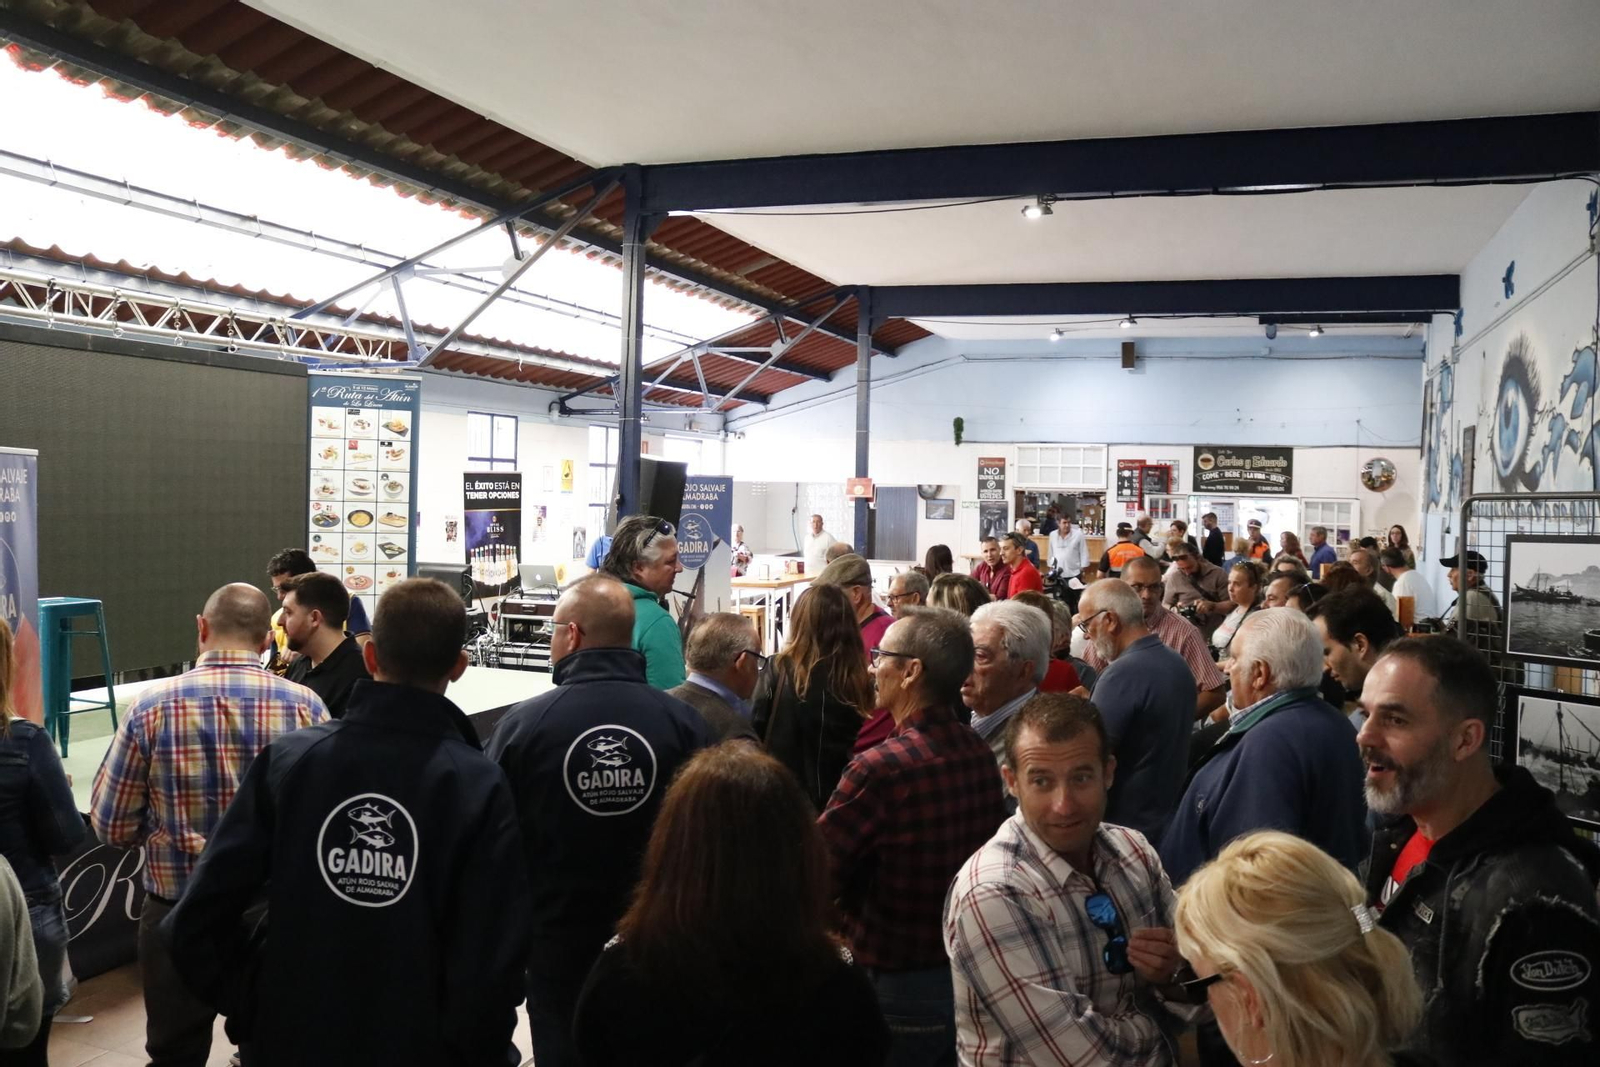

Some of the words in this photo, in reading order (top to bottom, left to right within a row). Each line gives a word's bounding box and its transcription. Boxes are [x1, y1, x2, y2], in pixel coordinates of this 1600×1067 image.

[327, 385, 362, 399] Ruta
[375, 388, 411, 402] Atún
[1216, 455, 1244, 467] Carlos
[1252, 456, 1288, 468] Eduardo
[0, 468, 27, 484] ALVAJE
[983, 467, 999, 475] NO
[1202, 472, 1219, 480] COME
[465, 482, 473, 490] EL
[475, 480, 493, 490] ÉXITO
[494, 481, 510, 490] ESTÁ
[511, 482, 520, 490] EN
[684, 483, 698, 492] OJO
[699, 484, 726, 492] SALVAJE
[466, 491, 488, 499] TENER
[489, 491, 519, 499] OPCIONES
[683, 493, 719, 501] MADRABA
[677, 541, 709, 553] GADIRA
[577, 767, 645, 790] GADIRA
[617, 788, 644, 796] SALVAJE
[328, 847, 407, 881] GADIRA
[337, 876, 357, 884] ATÚN
[358, 878, 375, 886] ROJO
[356, 886, 394, 896] ALMADRABA
[1520, 962, 1545, 978] Von
[1543, 958, 1580, 977] Dutch
